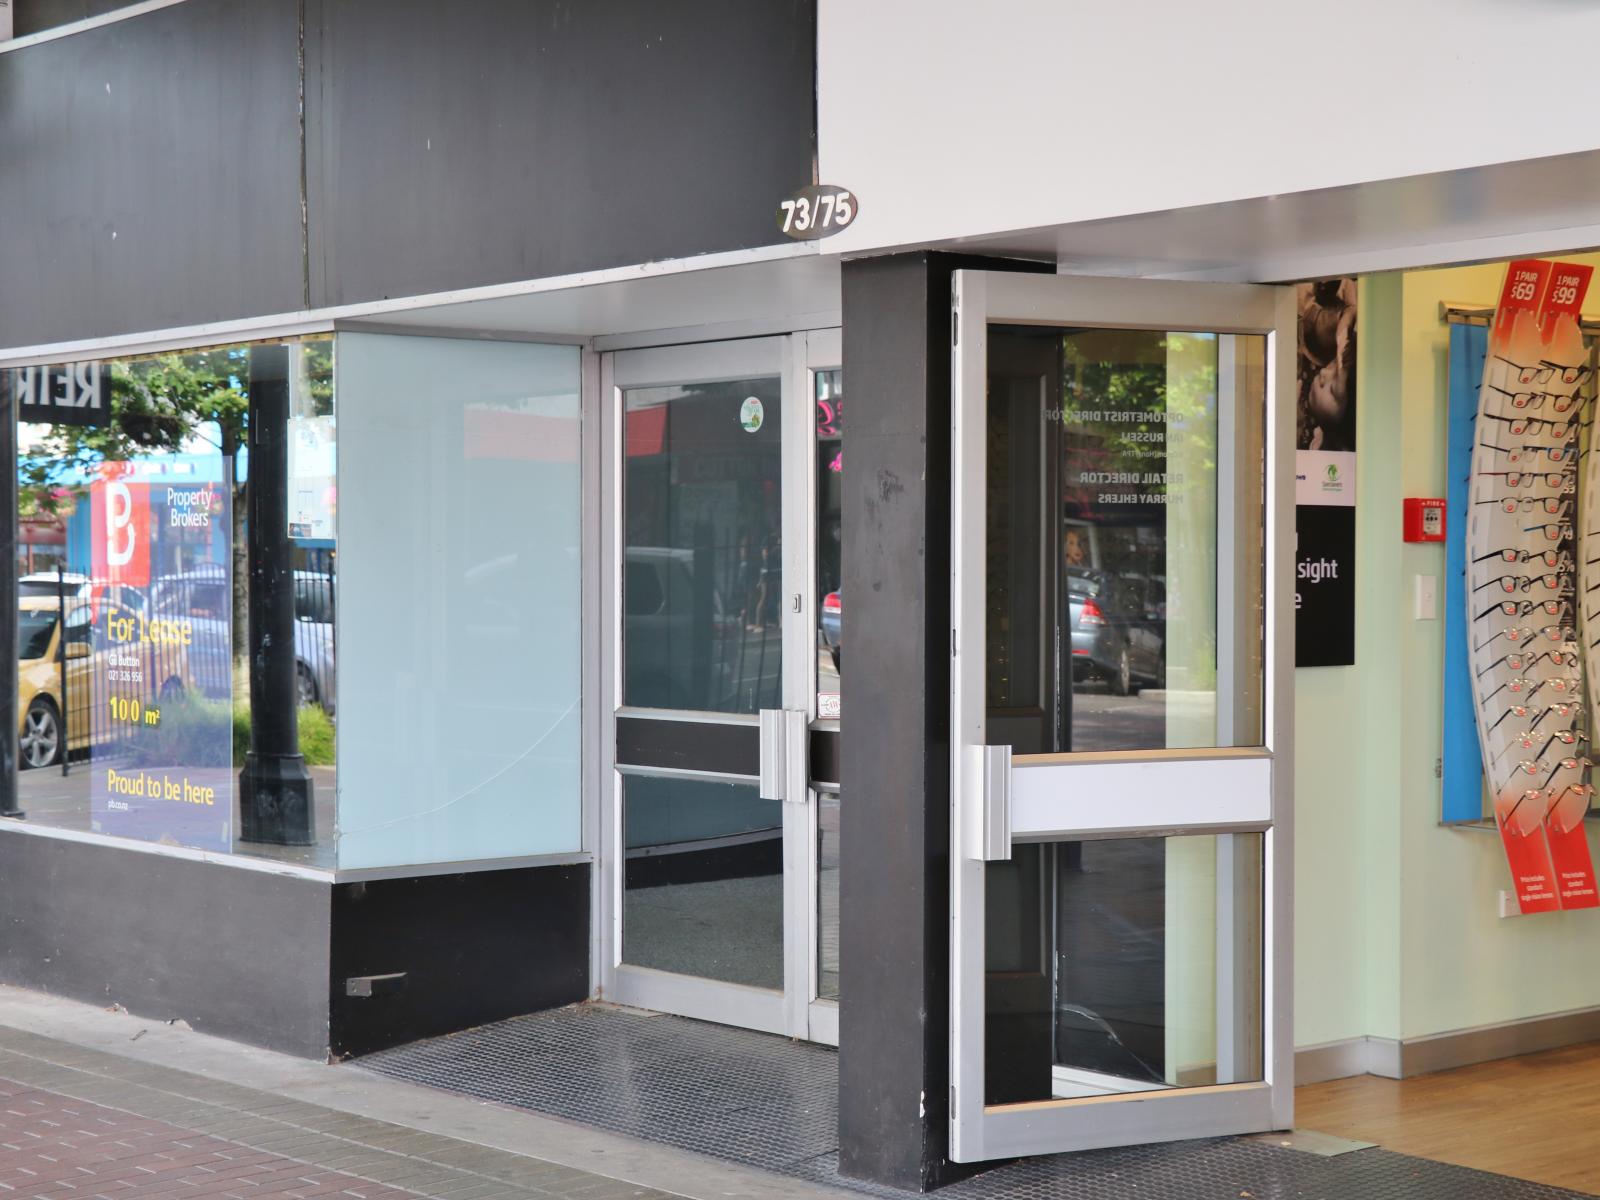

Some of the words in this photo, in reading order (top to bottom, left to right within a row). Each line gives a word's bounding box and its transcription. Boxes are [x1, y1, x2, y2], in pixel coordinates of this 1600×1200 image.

[781, 192, 851, 233] 73/75
[1515, 271, 1520, 281] 1
[1520, 271, 1538, 282] PAIR
[1556, 275, 1562, 285] 1
[1562, 275, 1580, 287] PAIR
[1511, 283, 1535, 300] $69
[1552, 287, 1576, 305] $99
[167, 487, 212, 510] Property
[171, 508, 208, 526] Brokers
[1297, 557, 1338, 583] sight
[107, 608, 135, 641] For
[140, 610, 192, 645] Lease
[118, 655, 140, 667] Button
[108, 670, 118, 681] 021
[108, 768, 144, 796] Proud
[147, 775, 161, 798] to
[164, 775, 181, 801] be
[184, 777, 214, 805] here
